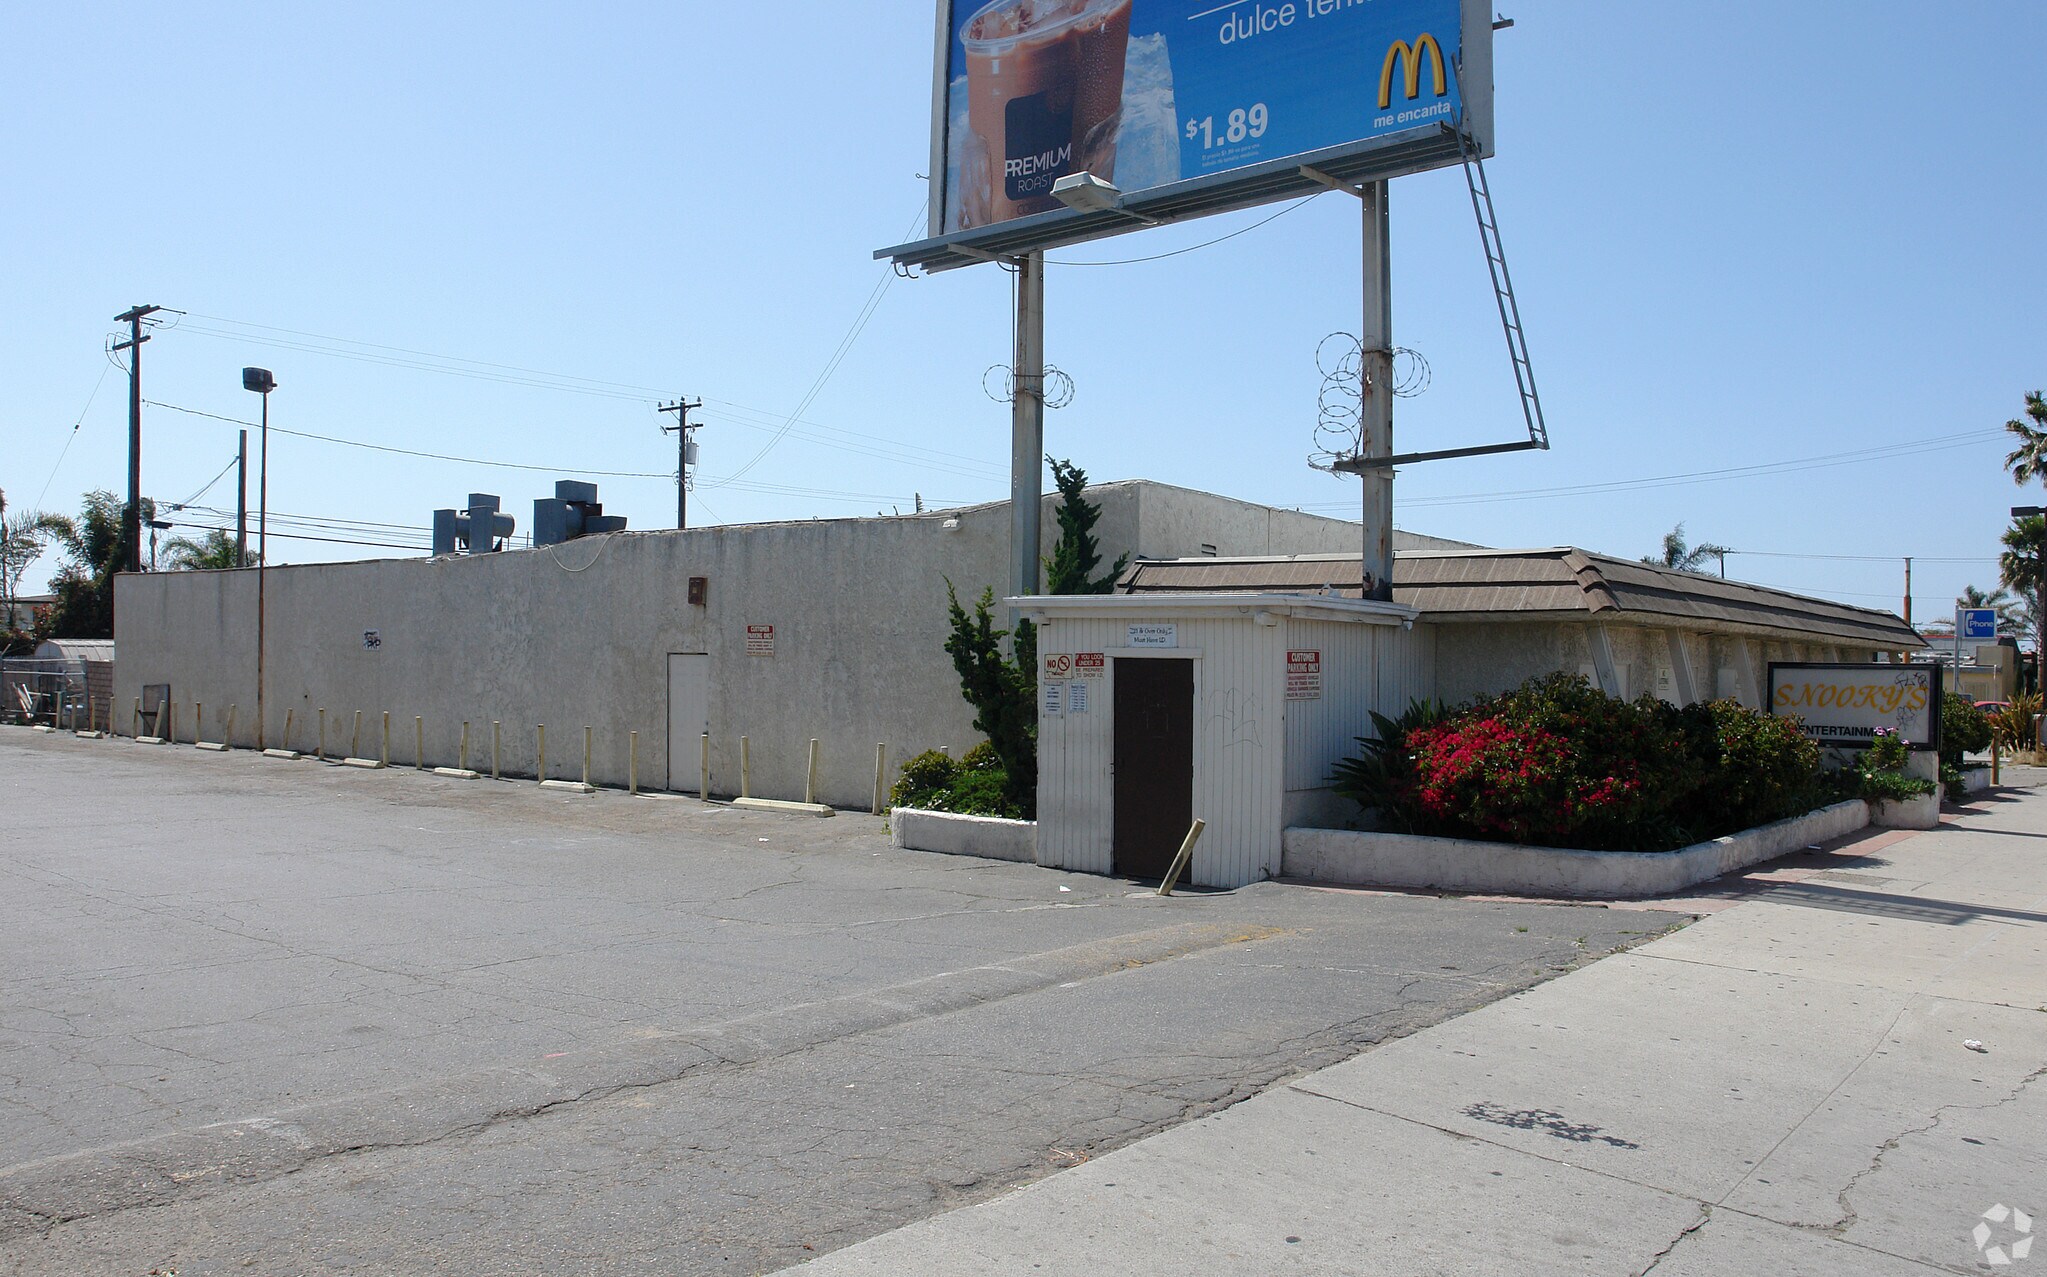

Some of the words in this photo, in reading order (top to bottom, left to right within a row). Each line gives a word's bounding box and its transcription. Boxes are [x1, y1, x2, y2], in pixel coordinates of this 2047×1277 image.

[1219, 3, 1296, 45] dulce
[1373, 115, 1394, 128] me
[1397, 101, 1451, 123] encanta
[1185, 102, 1269, 150] $1.89
[1005, 142, 1072, 177] PREMIUM
[1017, 172, 1054, 192] ROAST
[1970, 620, 1994, 628] Phone
[1046, 659, 1057, 669] NO
[1288, 662, 1307, 672] PARKING
[1308, 662, 1318, 672] ONLY
[1292, 652, 1315, 662] CUSTOMER
[1774, 682, 1927, 714] SNOOKY'S
[1798, 724, 1899, 738] ENTERTAINM
